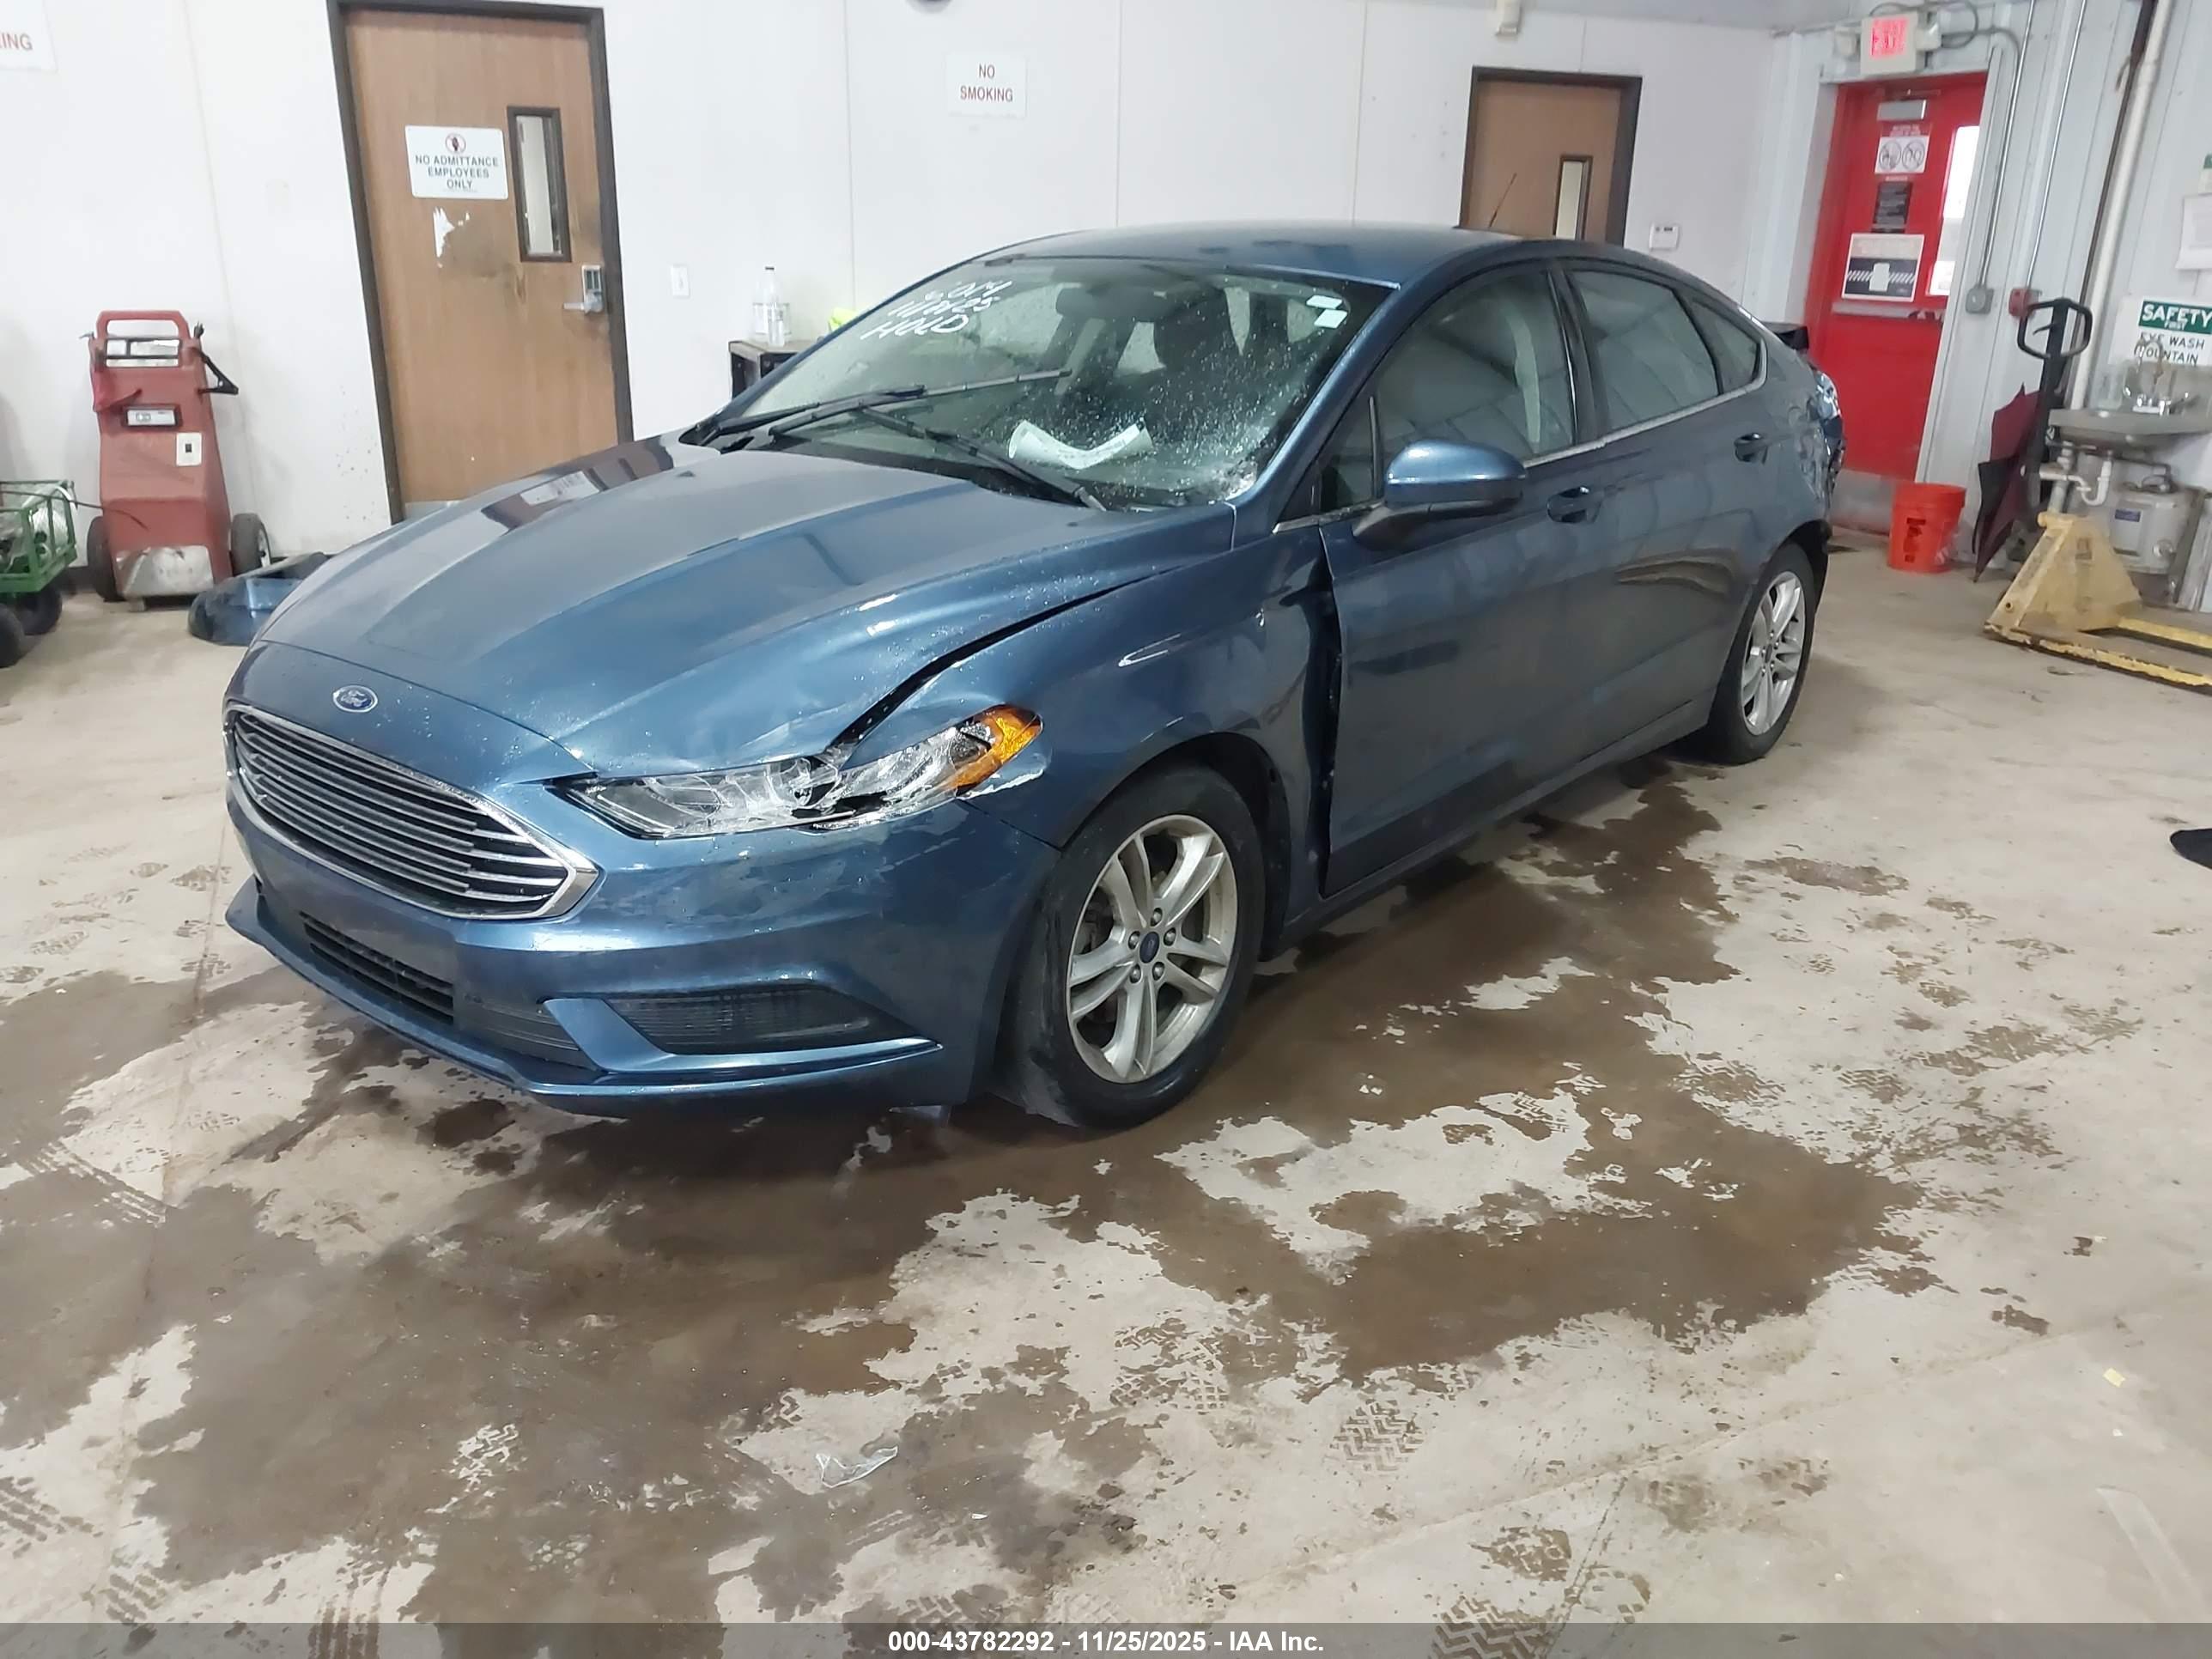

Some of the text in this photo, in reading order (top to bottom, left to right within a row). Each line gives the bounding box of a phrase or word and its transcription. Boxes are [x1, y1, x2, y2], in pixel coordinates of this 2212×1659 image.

[0, 32, 33, 52] ING
[978, 63, 996, 79] NO
[960, 85, 1013, 103] SMOKING
[415, 155, 498, 167] NO ADMITTANCE
[428, 167, 489, 179] EMPLOYEES
[447, 179, 473, 189] ONLY
[2142, 303, 2212, 328] SAFETY
[860, 313, 969, 340] HOLD
[2169, 336, 2205, 349] WASH
